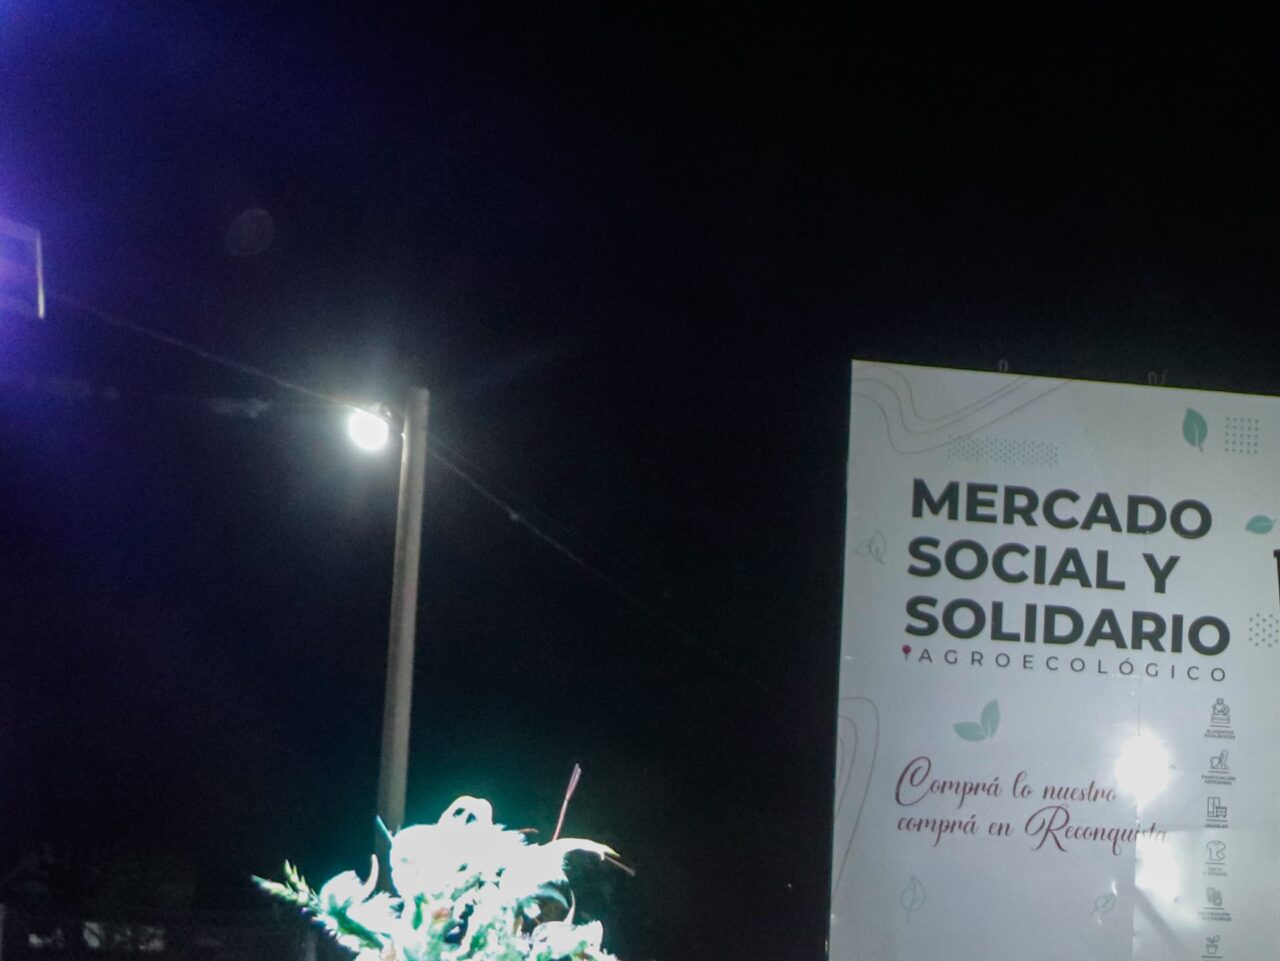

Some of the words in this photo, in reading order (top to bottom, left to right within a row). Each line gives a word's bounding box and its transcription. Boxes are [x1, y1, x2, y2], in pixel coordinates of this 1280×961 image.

[911, 478, 1212, 539] MERCADO
[907, 536, 1125, 591] SOCIAL
[1142, 553, 1180, 594] Y
[904, 596, 1230, 656] SOLIDARIO
[918, 648, 1226, 683] AGROECOLÓGICO
[895, 756, 1001, 809] Comprá
[1012, 770, 1033, 798] lo
[1042, 780, 1116, 802] nuestro
[897, 814, 977, 847] comprá
[988, 823, 1012, 837] en
